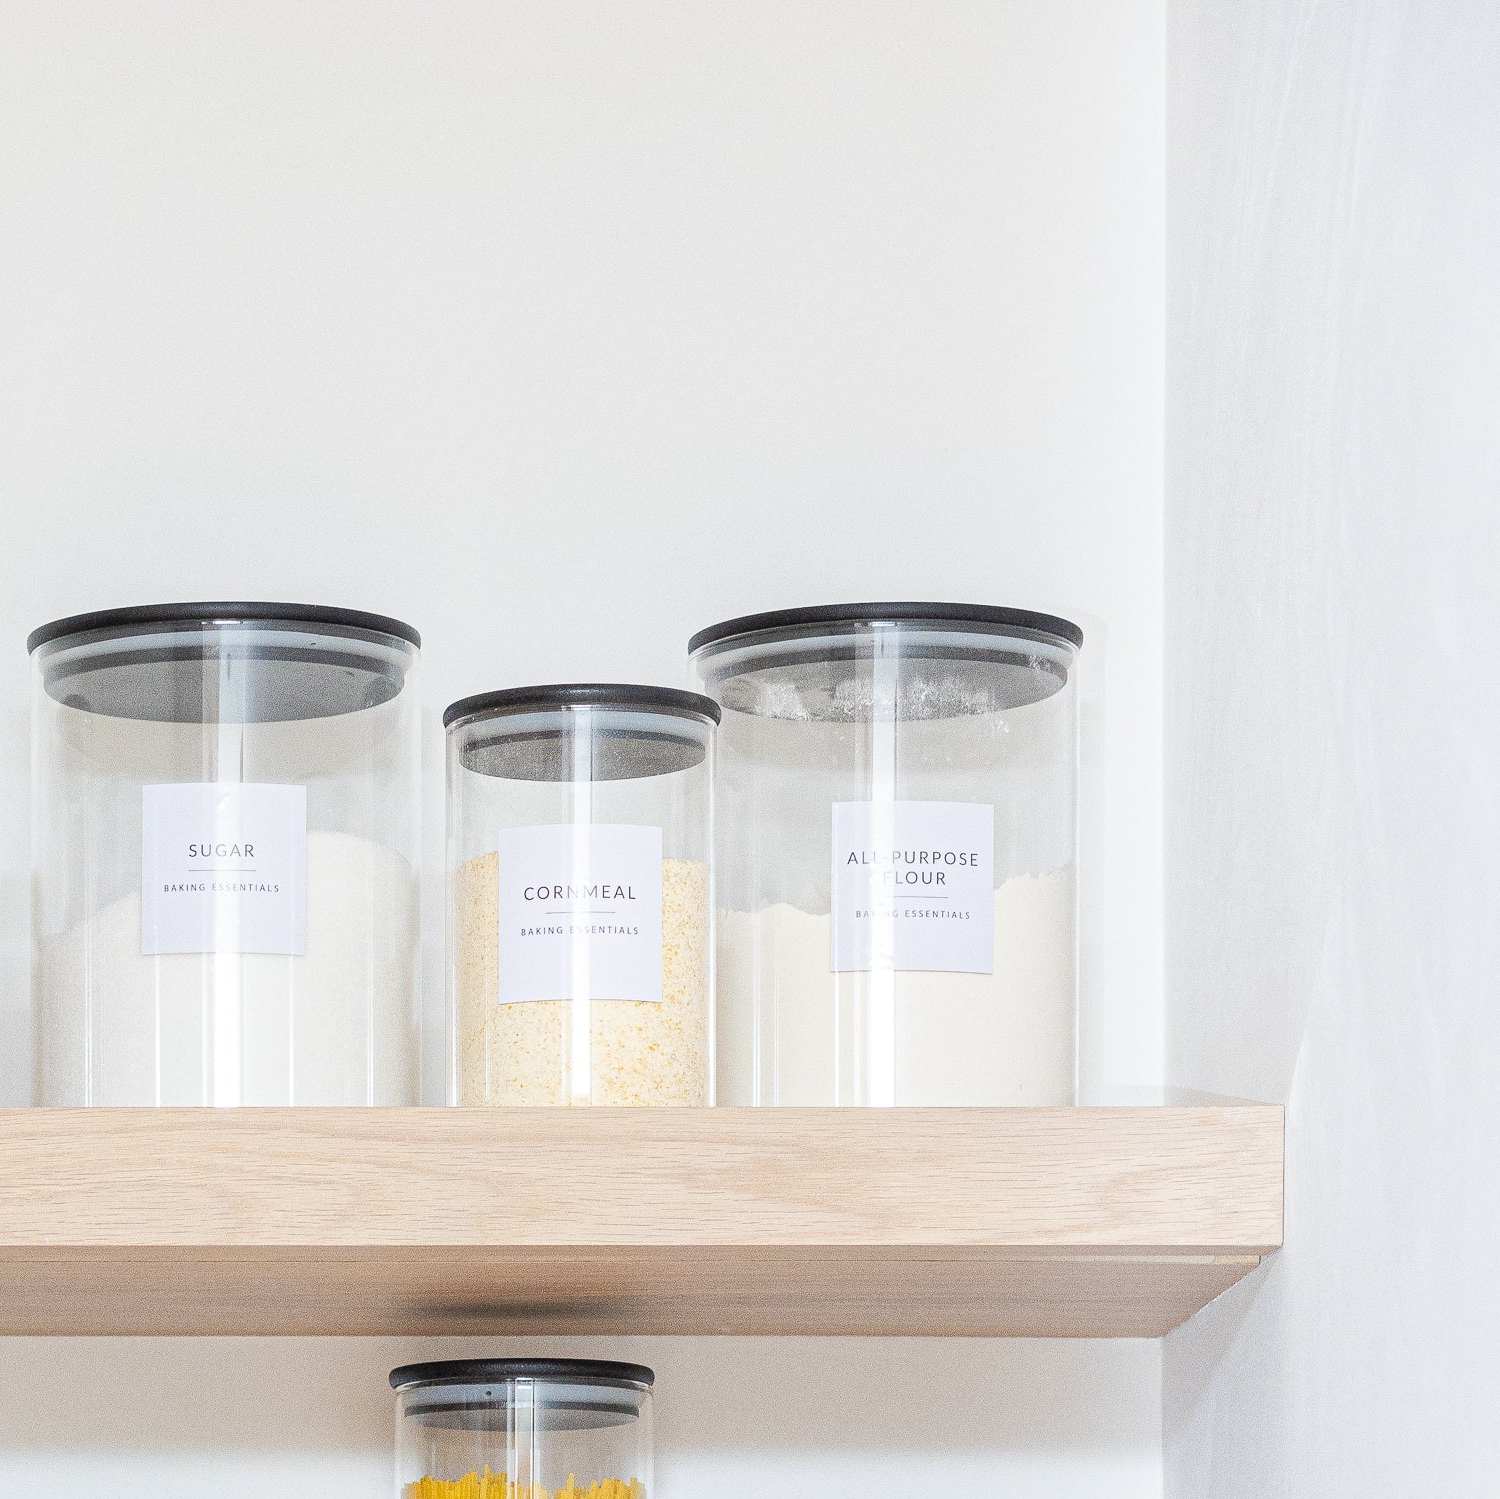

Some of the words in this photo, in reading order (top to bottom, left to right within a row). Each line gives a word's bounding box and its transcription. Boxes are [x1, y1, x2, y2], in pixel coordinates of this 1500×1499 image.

[188, 840, 255, 858] SUGAR
[846, 849, 979, 868] ALL-PURPOSE
[163, 882, 206, 894] BAKING
[211, 882, 280, 894] ESSENTIALS
[880, 870, 947, 888] FLOUR
[523, 884, 637, 905] CORNMEAL
[855, 909, 899, 919] BAKNG
[904, 909, 971, 920] ESSENTIALS
[520, 925, 564, 937] BAKING
[569, 925, 640, 936] ESSENTIALS
